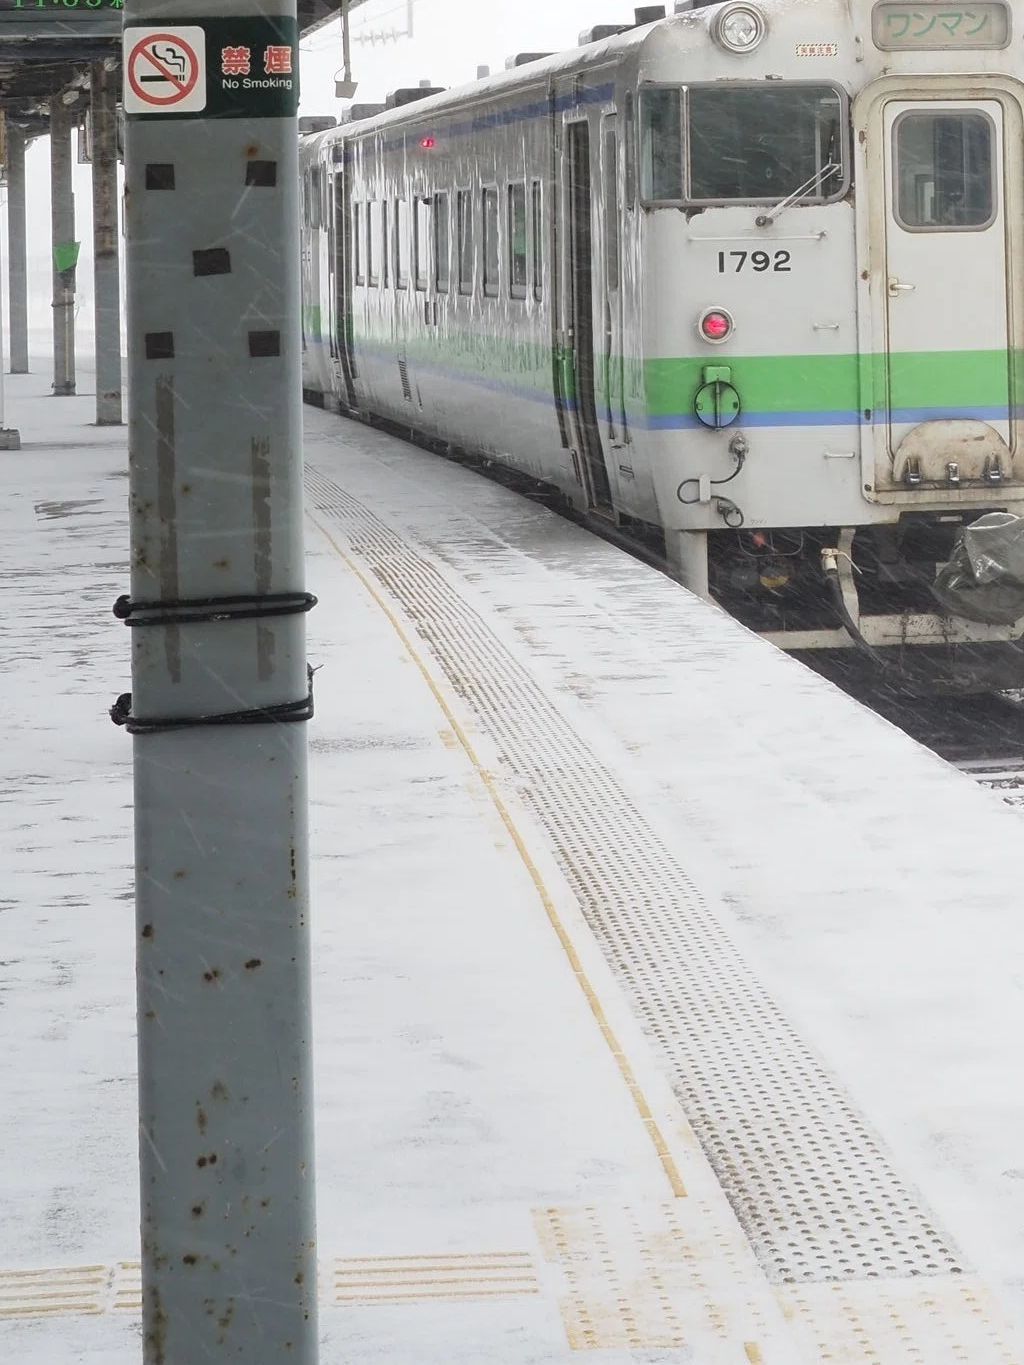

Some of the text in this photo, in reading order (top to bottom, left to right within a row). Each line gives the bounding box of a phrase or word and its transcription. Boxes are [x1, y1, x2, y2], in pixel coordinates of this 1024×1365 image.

[886, 11, 989, 39] ワンマン
[221, 45, 293, 76] 禁煙
[222, 77, 293, 90] No Smoking
[718, 250, 791, 274] 1792
